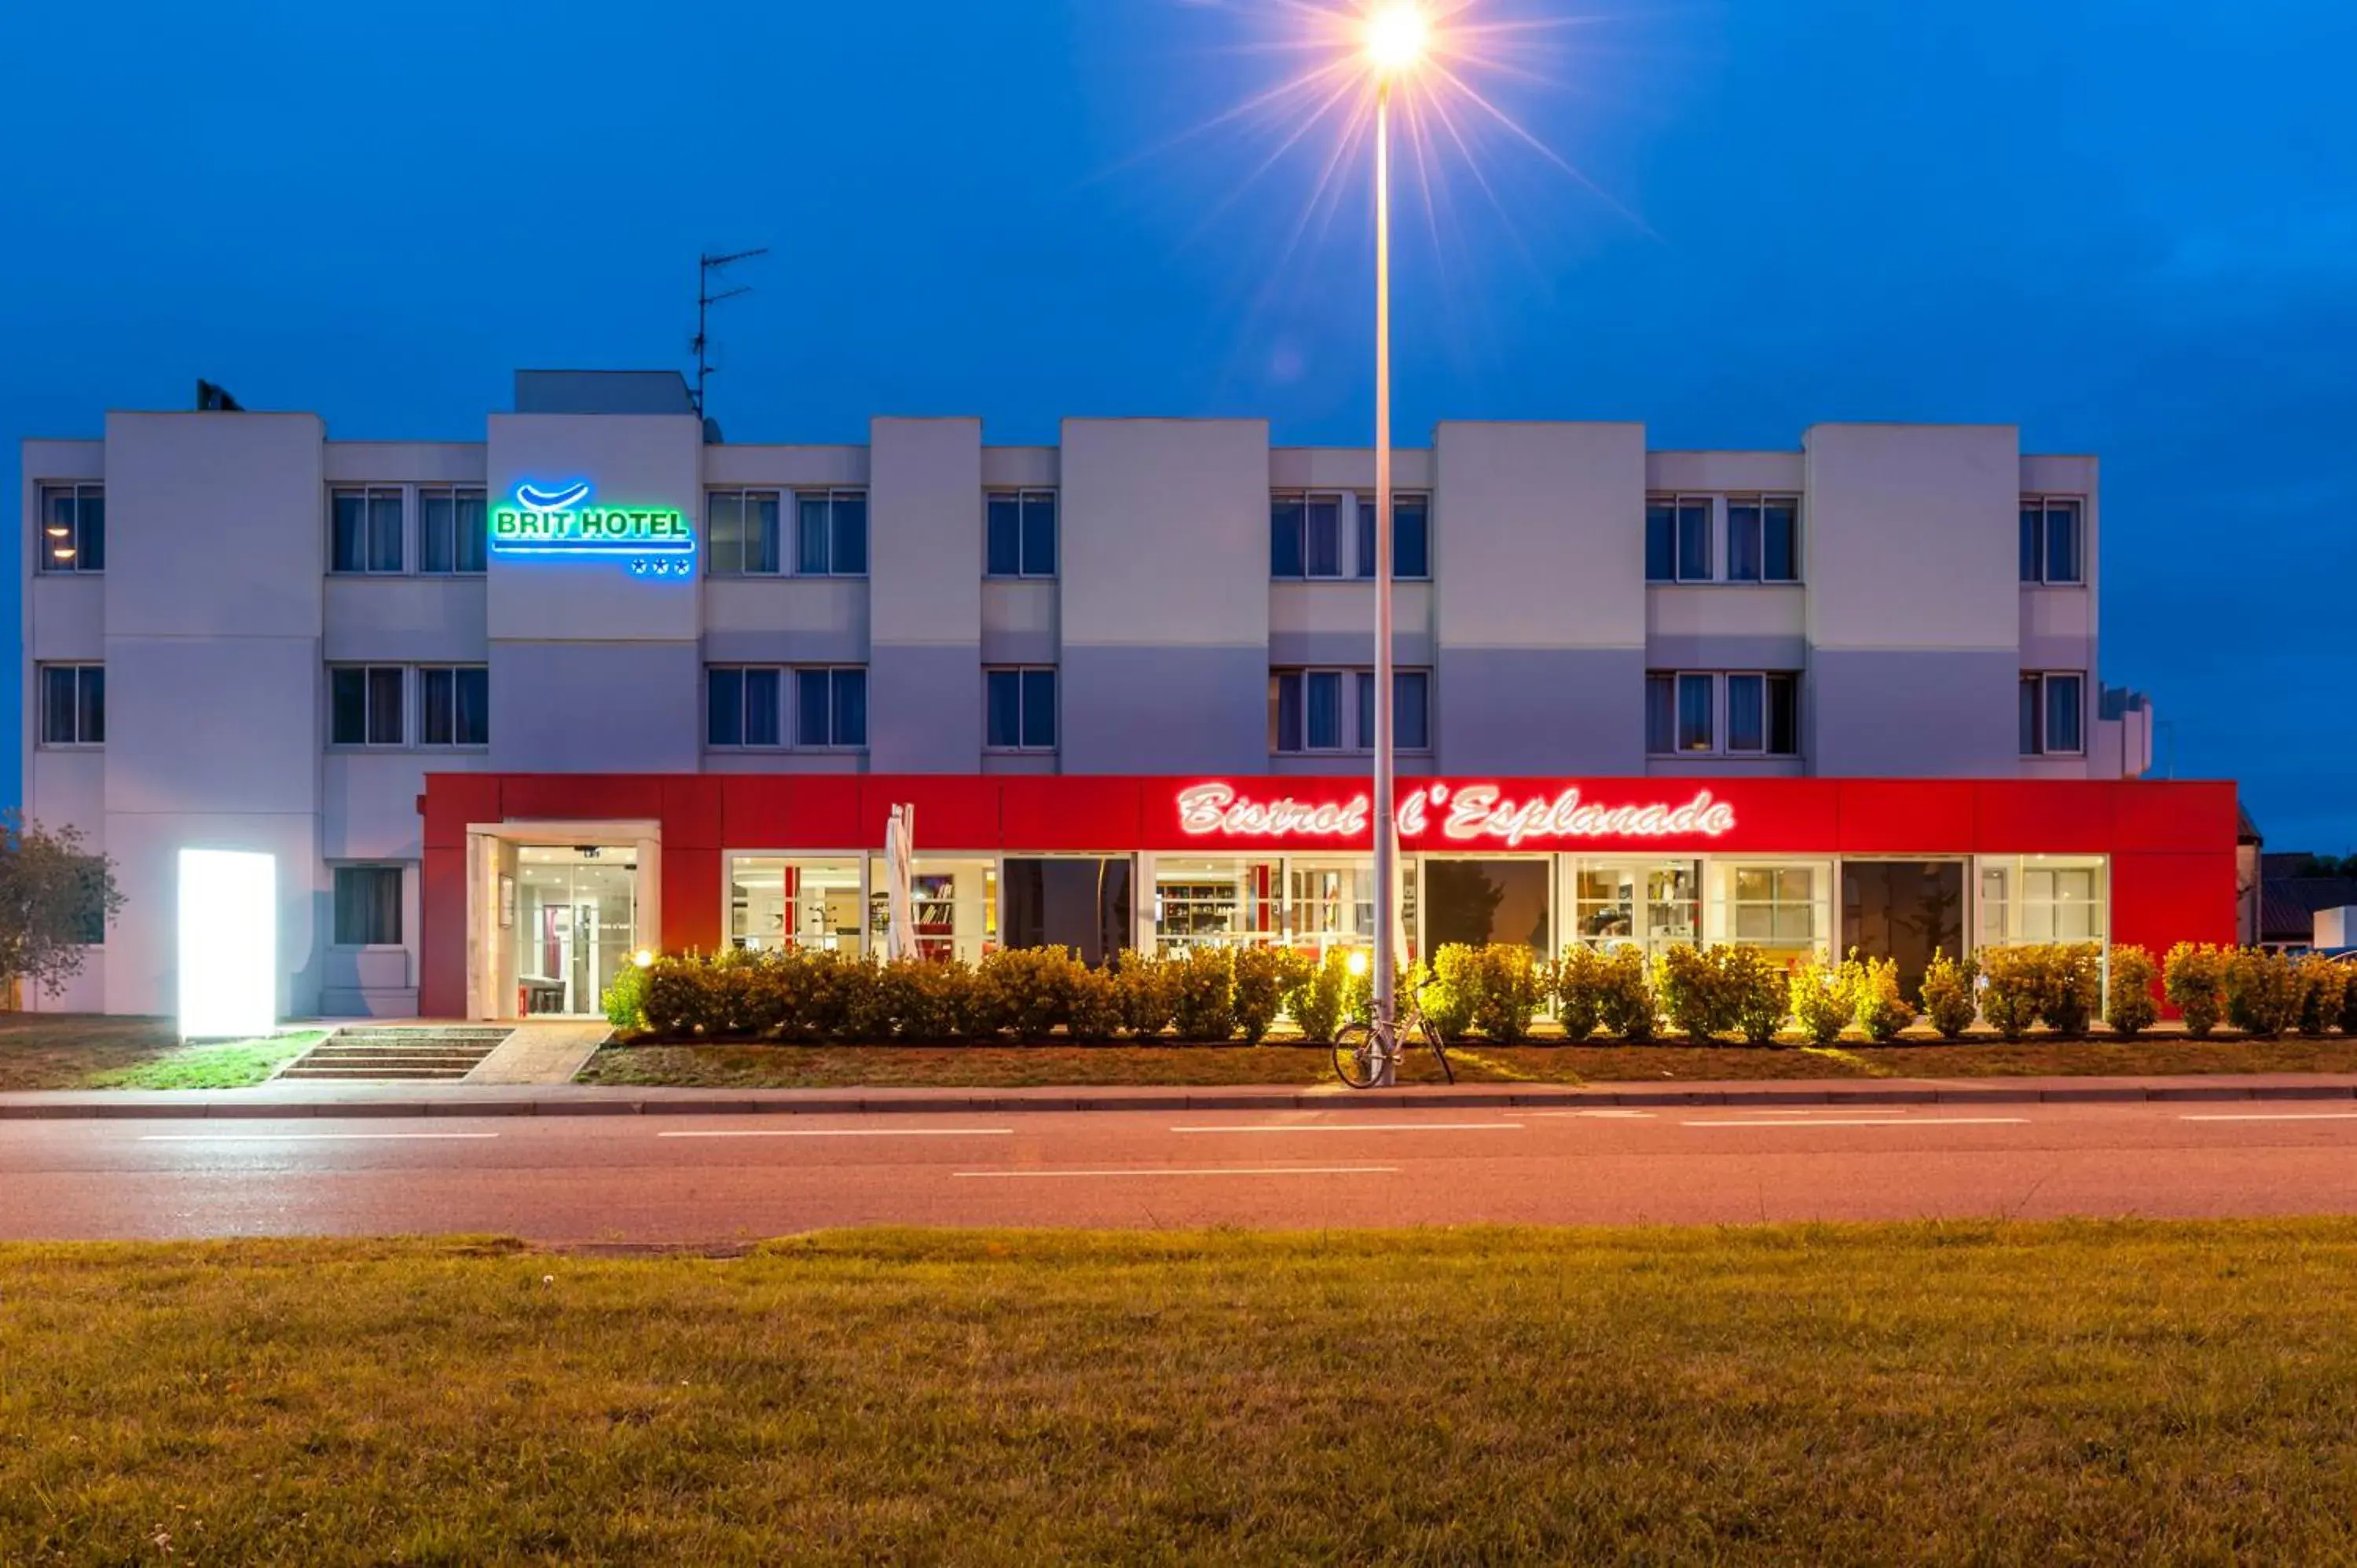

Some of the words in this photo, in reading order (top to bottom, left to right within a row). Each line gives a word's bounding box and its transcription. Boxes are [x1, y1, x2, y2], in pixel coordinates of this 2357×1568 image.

[497, 511, 571, 534] BRIT
[581, 512, 688, 536] HOTEL
[1178, 782, 1369, 835] Bistrot
[1398, 783, 1735, 846] l'Esplanade
